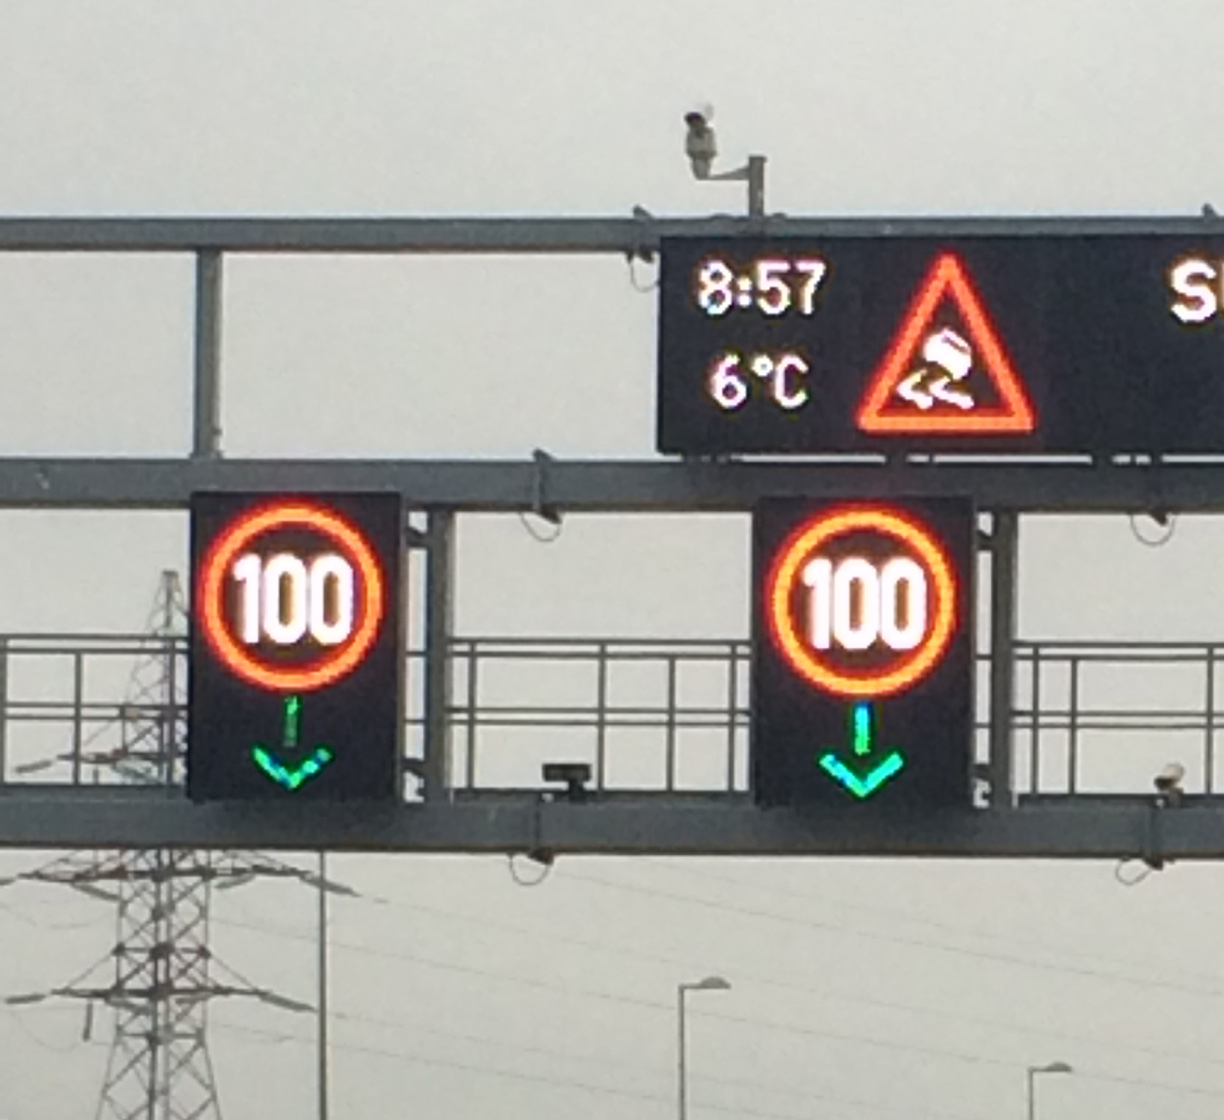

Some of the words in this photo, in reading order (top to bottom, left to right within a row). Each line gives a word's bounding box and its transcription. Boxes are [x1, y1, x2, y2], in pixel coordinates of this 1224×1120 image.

[698, 260, 826, 314] 8:57
[711, 354, 808, 408] 6°C
[232, 553, 354, 645] 100
[802, 556, 927, 650] 100
